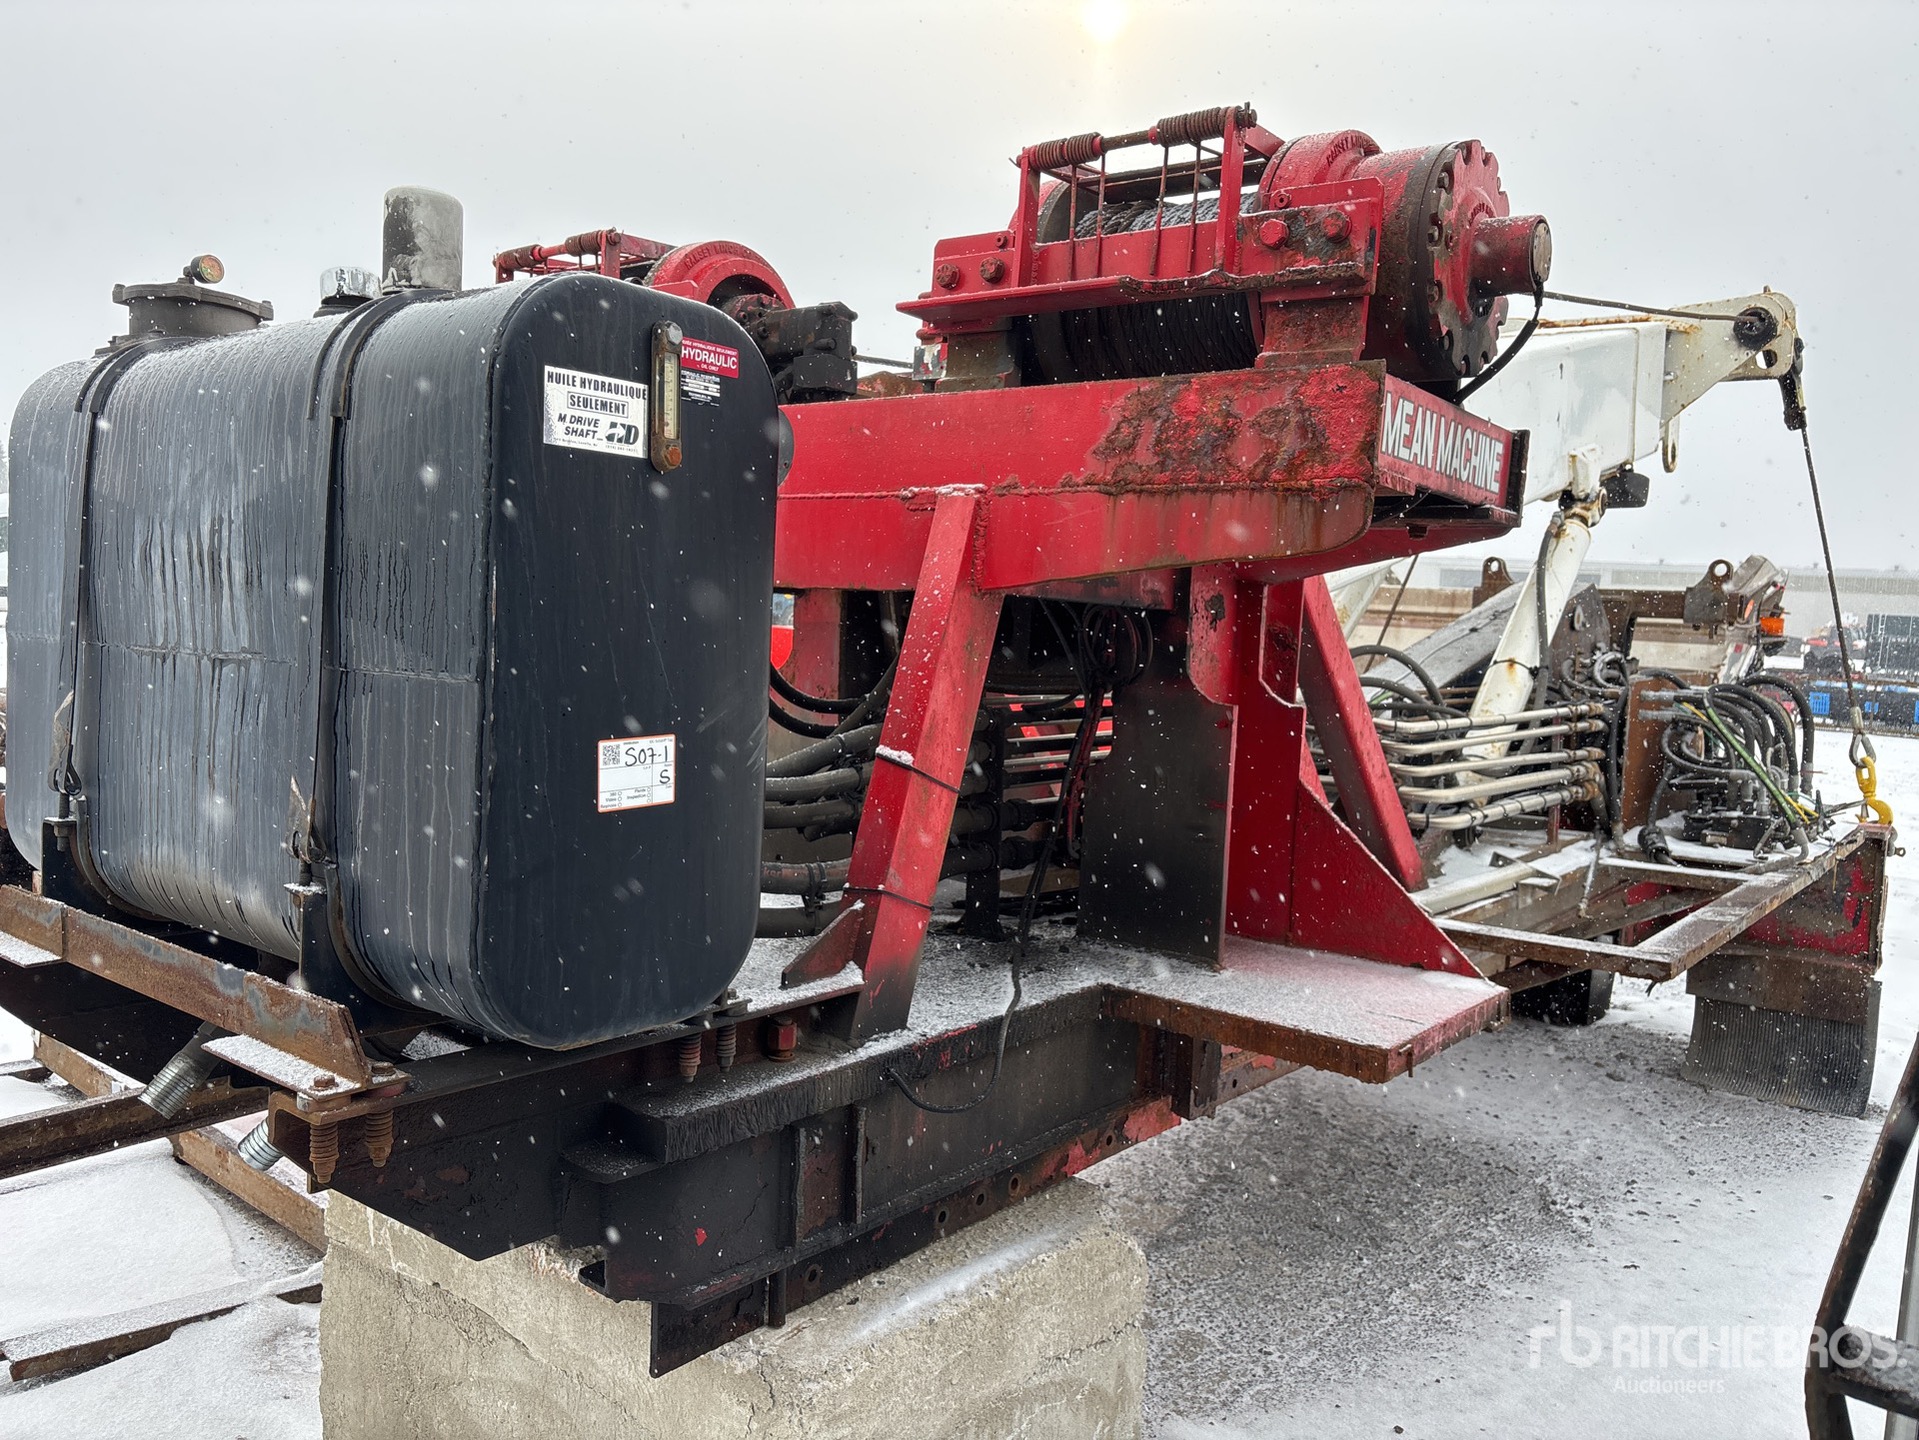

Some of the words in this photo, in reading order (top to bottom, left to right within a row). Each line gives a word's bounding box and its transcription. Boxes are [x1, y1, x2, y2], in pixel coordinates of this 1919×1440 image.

[681, 345, 737, 369] HYDRAULIC
[547, 370, 577, 388] HUILE
[579, 376, 647, 401] HYDRAULIQUE
[569, 394, 626, 416] SEULEMENT
[564, 425, 598, 440] SHAFT
[569, 414, 600, 429] DRIVE
[1380, 390, 1437, 470] MEAN
[1436, 415, 1505, 495] MACHINE
